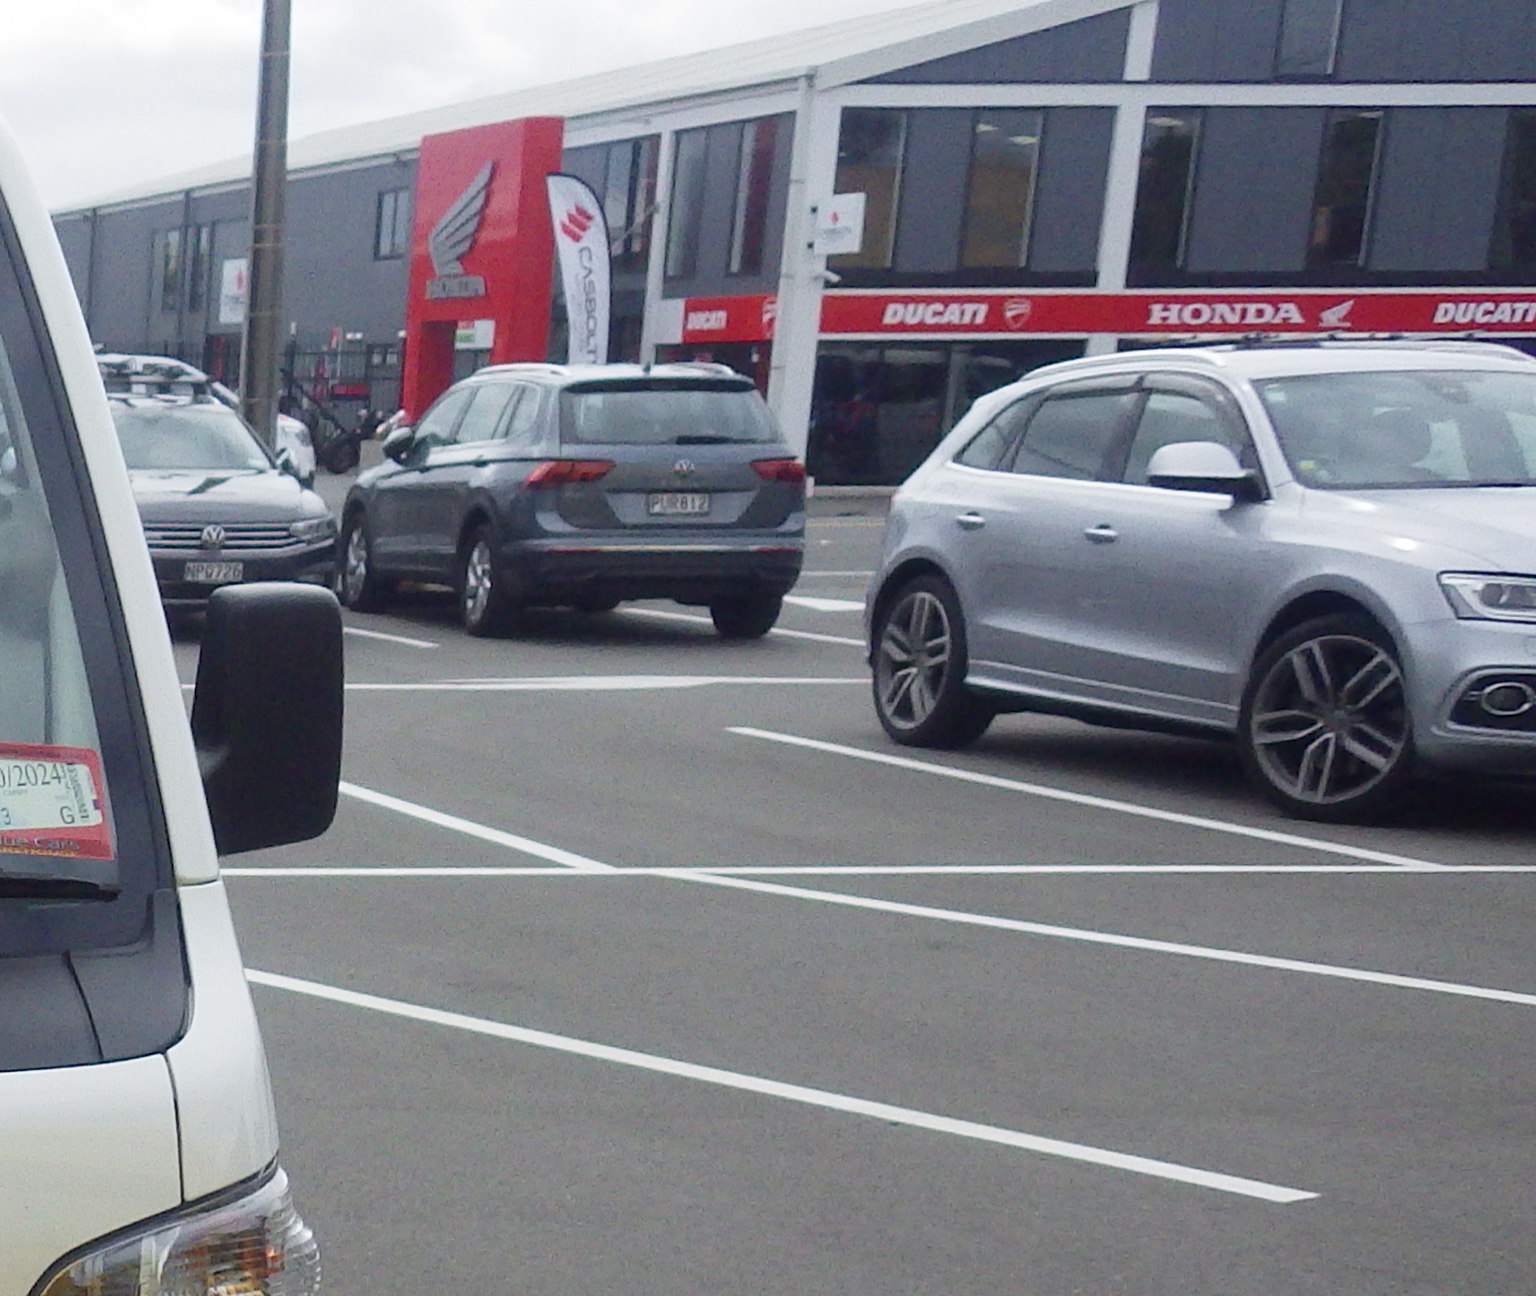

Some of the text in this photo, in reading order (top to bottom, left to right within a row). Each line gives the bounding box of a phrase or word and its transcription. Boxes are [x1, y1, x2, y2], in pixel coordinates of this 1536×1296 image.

[882, 302, 990, 325] DUCATI
[1146, 302, 1305, 325] HONDA
[1433, 302, 1536, 324] DUCATI
[59, 806, 75, 824] G
[35, 836, 80, 850] Cars
